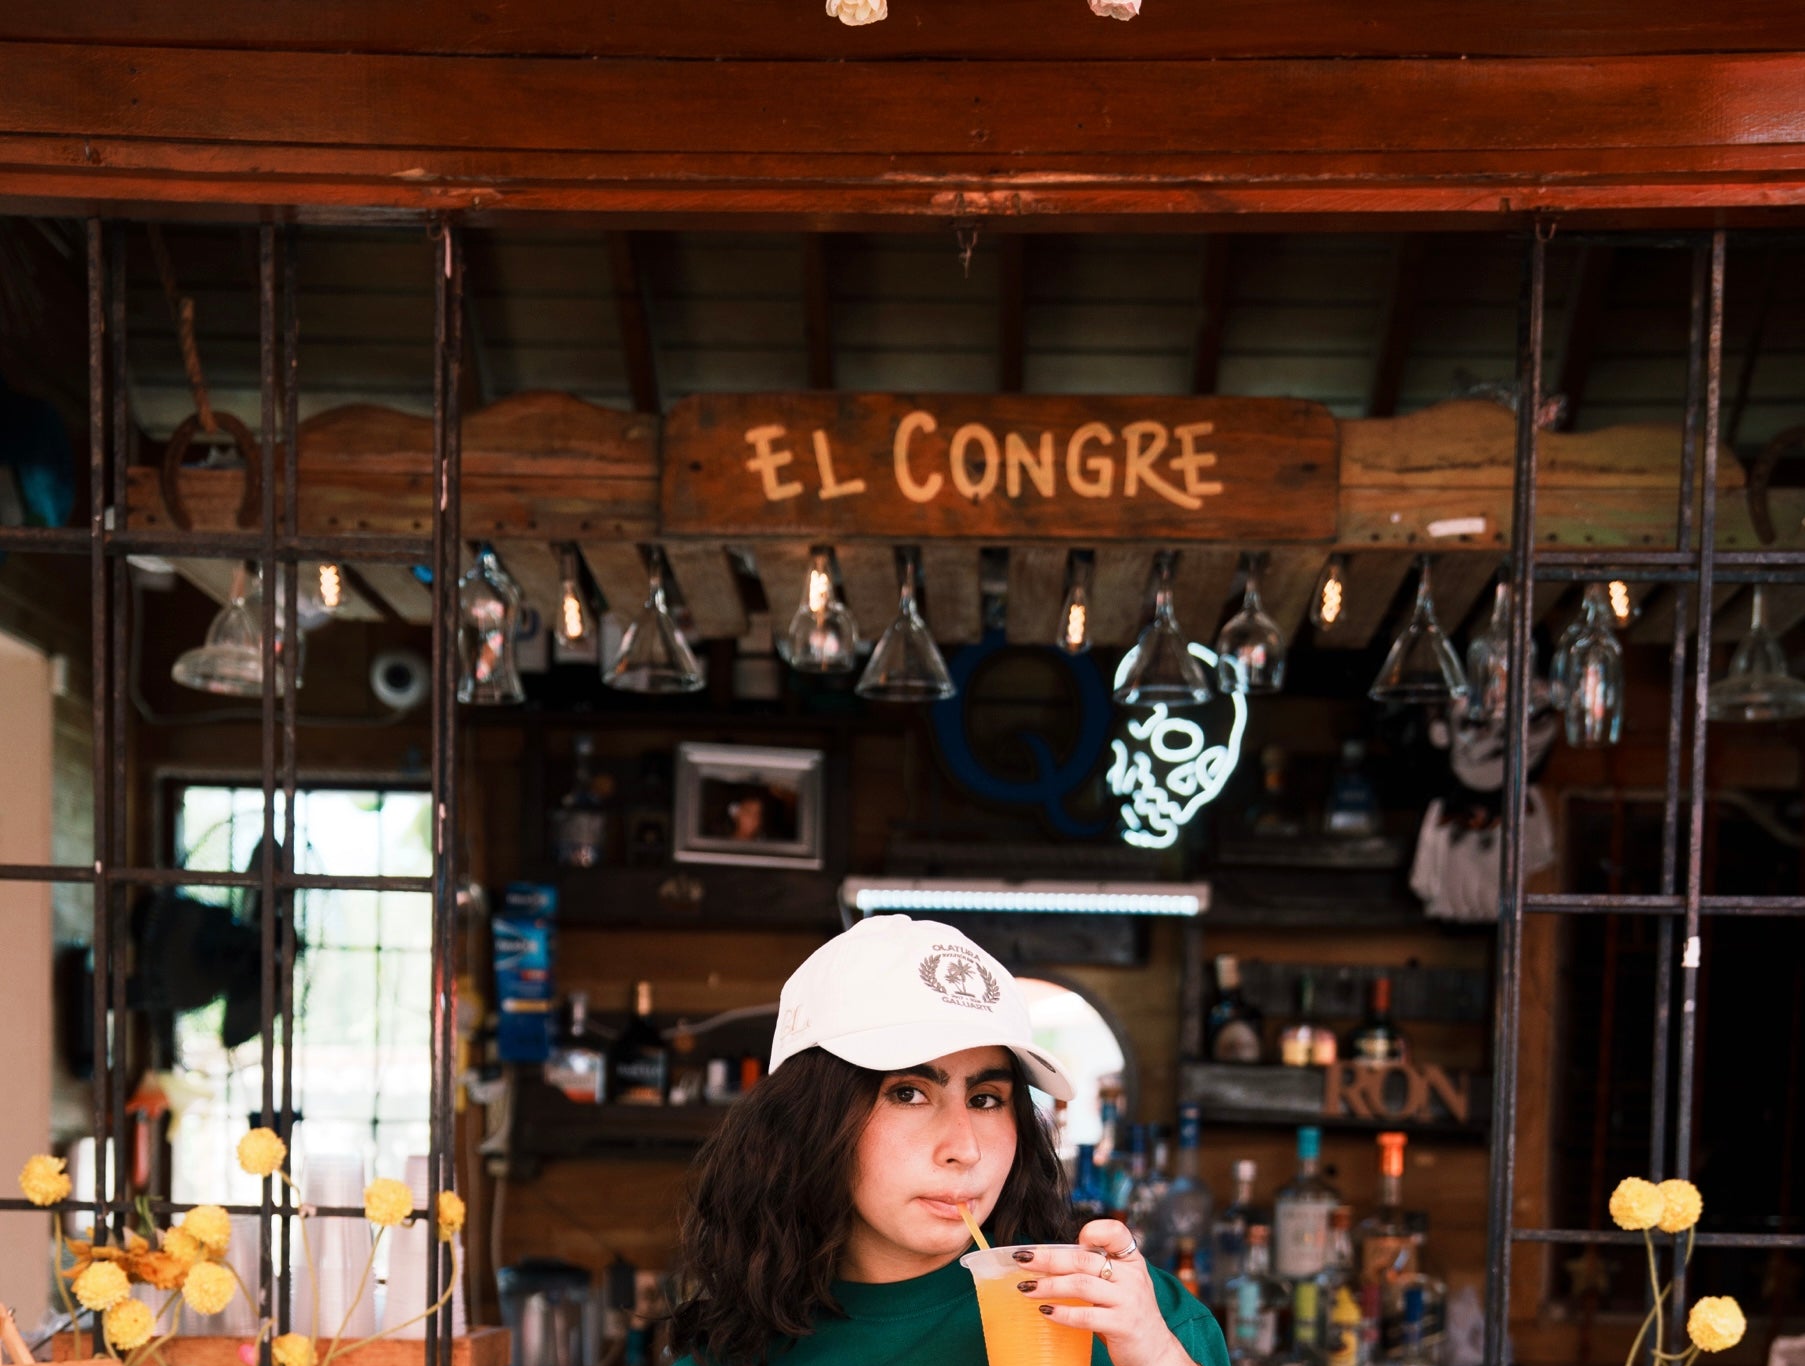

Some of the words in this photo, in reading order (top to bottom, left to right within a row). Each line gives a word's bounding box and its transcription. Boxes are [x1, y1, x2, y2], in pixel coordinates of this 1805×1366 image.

[745, 424, 866, 501] EL
[893, 410, 1223, 510] CONGRE
[932, 944, 981, 961] OLATURA
[1323, 1060, 1471, 1123] RON
